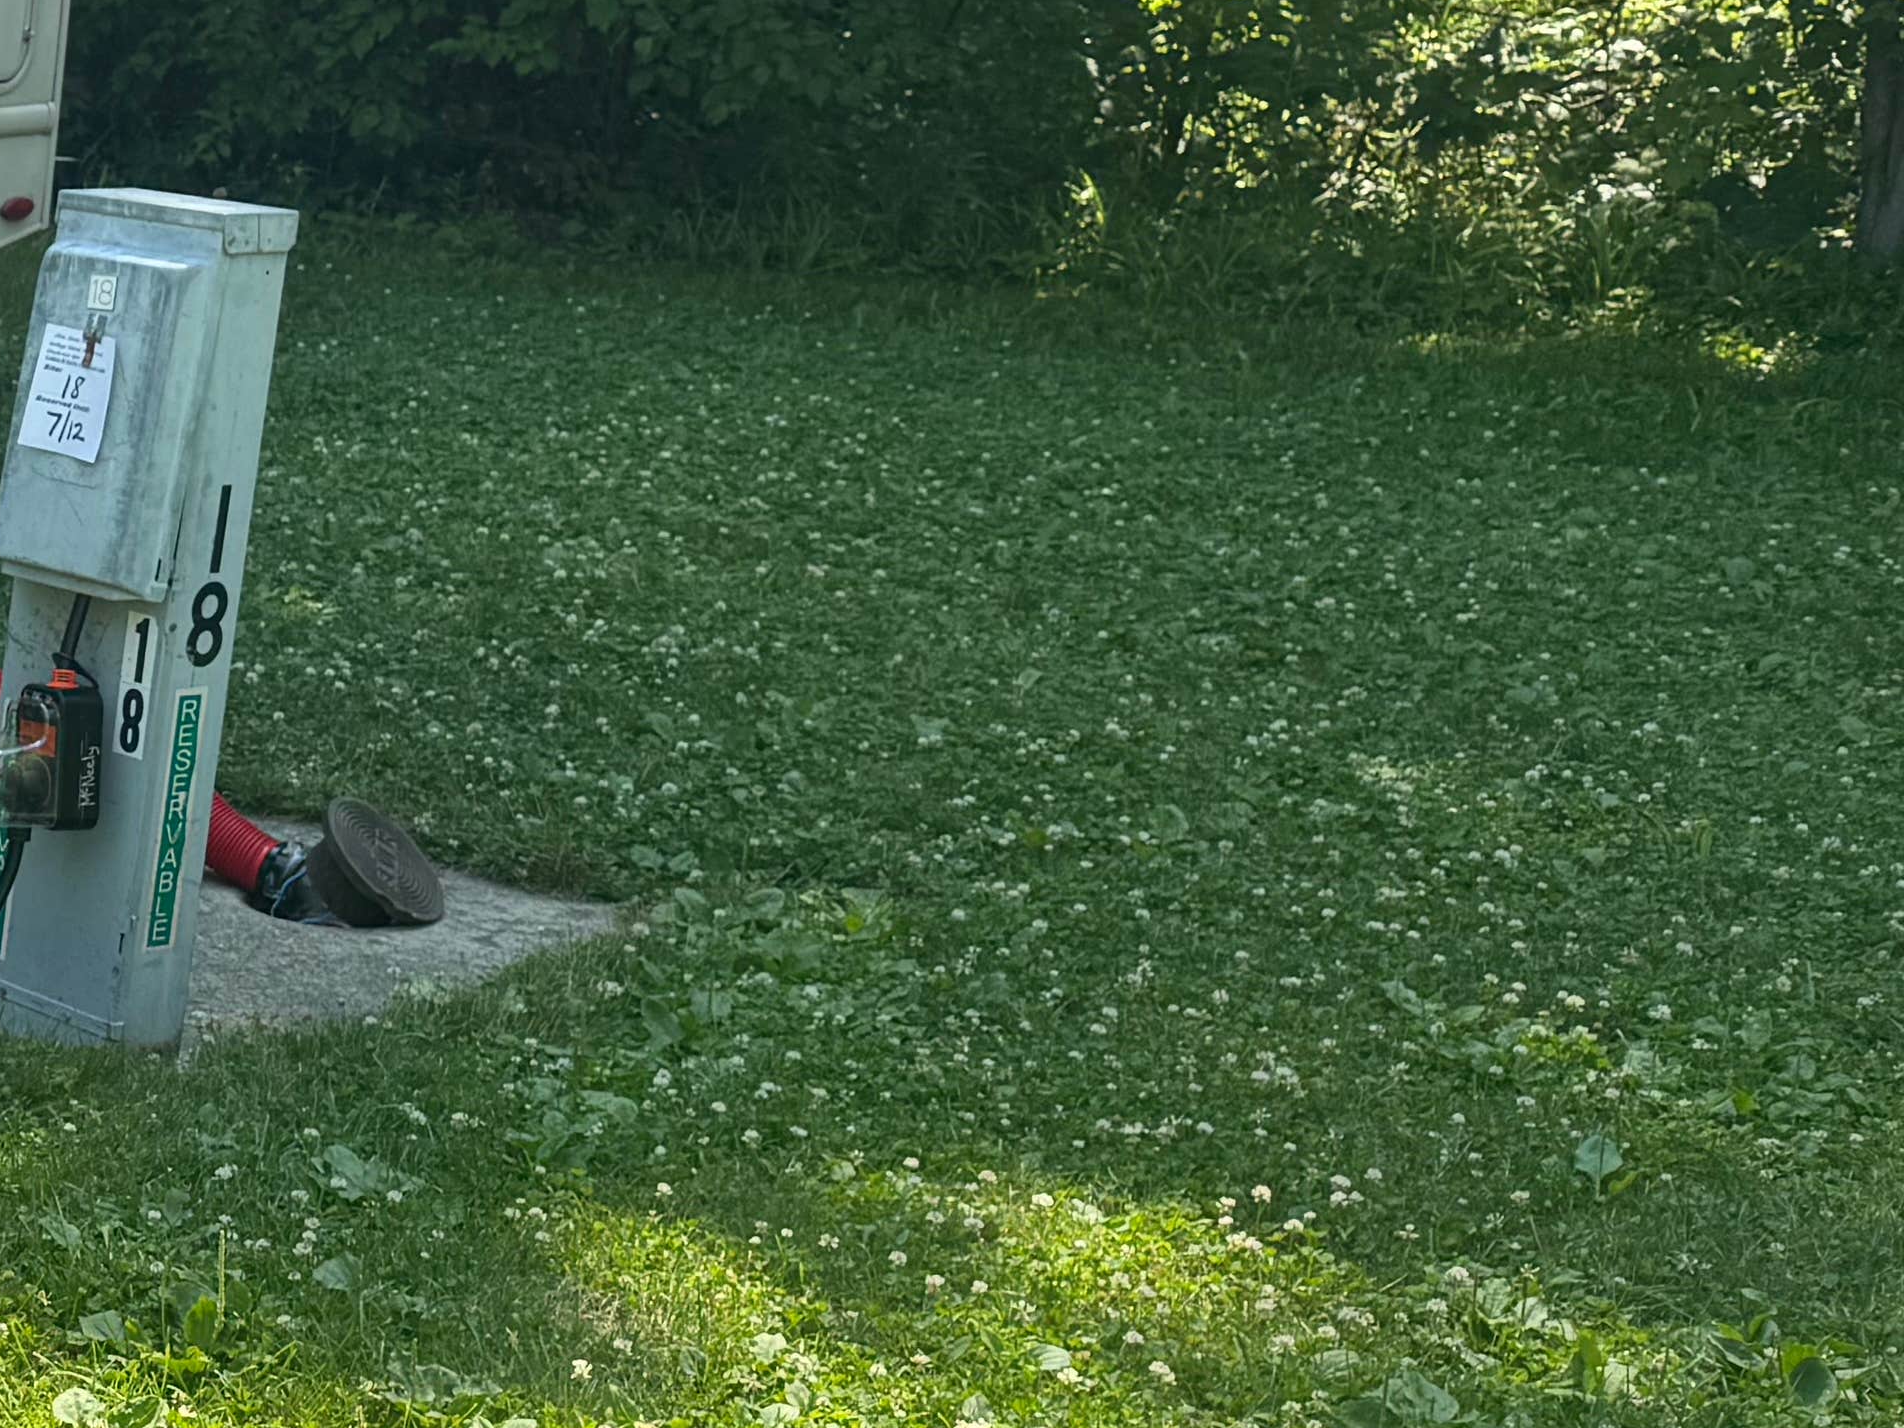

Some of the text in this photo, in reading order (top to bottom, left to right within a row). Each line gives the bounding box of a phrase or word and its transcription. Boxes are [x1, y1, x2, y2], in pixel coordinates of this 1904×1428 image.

[93, 278, 114, 306] 18
[46, 410, 86, 443] 7/12
[61, 374, 86, 400] 18
[186, 484, 232, 668] 18
[120, 618, 151, 754] 18
[151, 699, 198, 942] RESERVABLE
